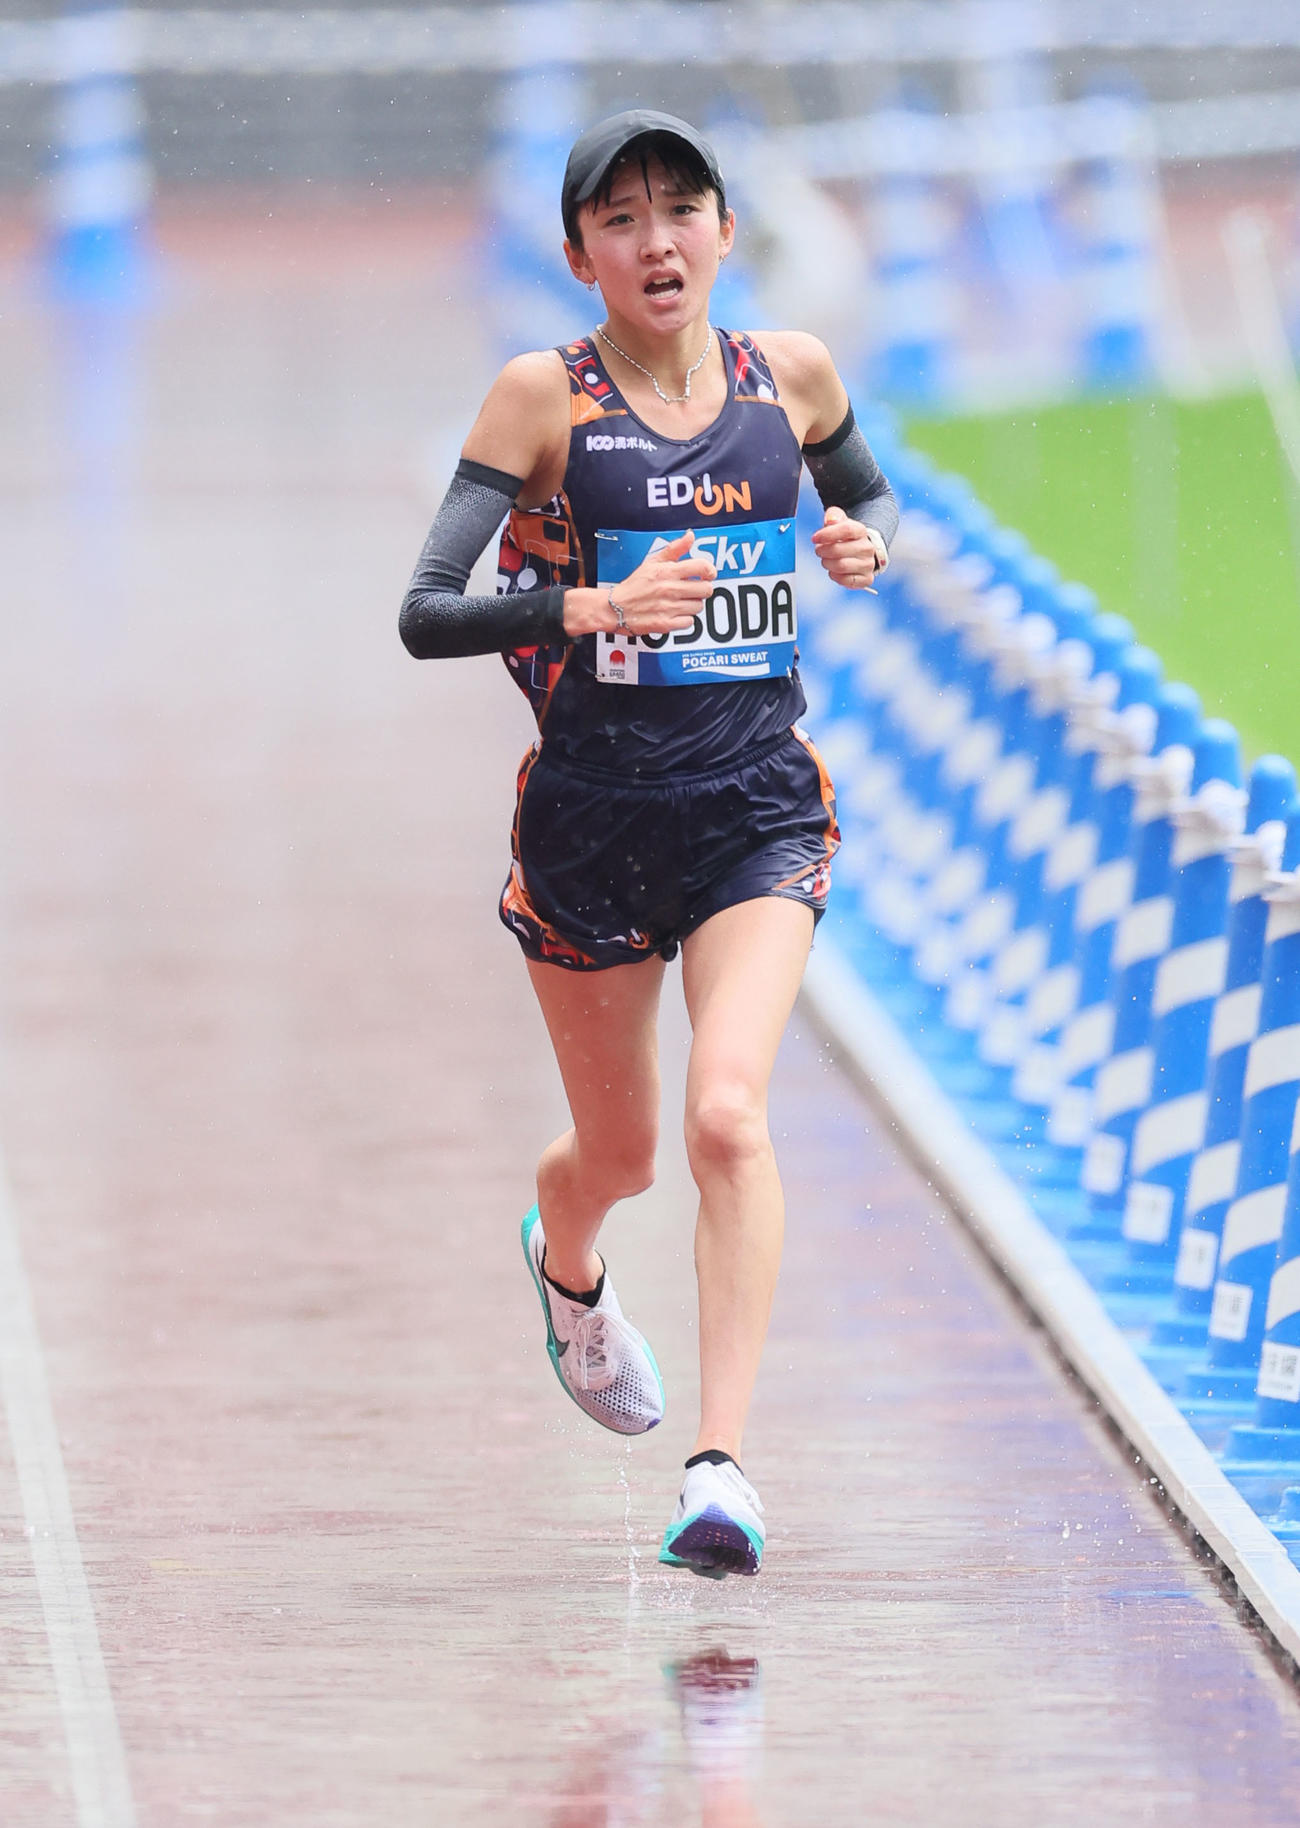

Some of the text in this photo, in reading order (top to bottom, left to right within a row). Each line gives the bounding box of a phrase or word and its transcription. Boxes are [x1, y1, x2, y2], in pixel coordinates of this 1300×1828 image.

[646, 473, 752, 516] EDION
[689, 536, 766, 575] Sky
[682, 654, 729, 668] POCARI
[730, 651, 769, 665] SWEAT
